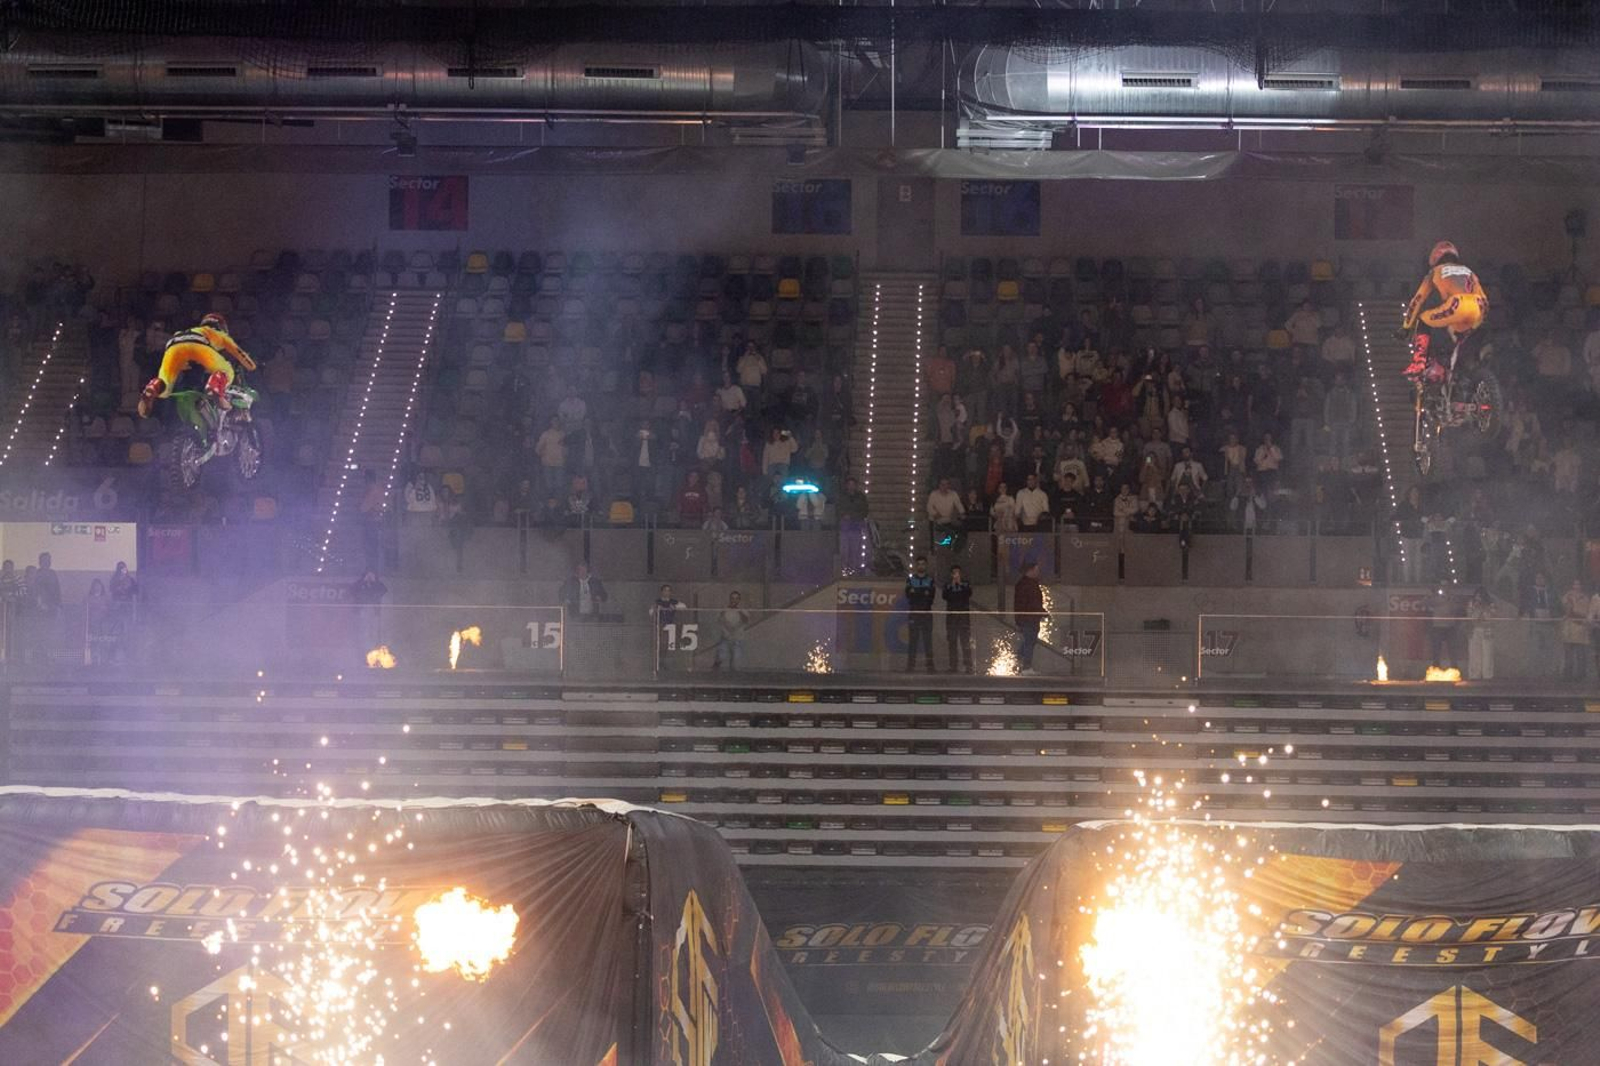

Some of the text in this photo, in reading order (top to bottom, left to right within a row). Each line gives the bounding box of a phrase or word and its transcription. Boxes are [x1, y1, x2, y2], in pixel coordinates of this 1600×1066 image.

[388, 175, 440, 189] Sector
[772, 182, 822, 194] Sector
[961, 182, 1012, 196] Sector
[402, 177, 467, 230] 14
[0, 475, 119, 511] Salida 6
[719, 532, 754, 544] Sector
[998, 534, 1034, 546] Sector
[287, 583, 347, 600] Sector
[838, 588, 897, 605] Sector
[526, 621, 561, 649] 15
[661, 623, 699, 651] 15
[1066, 630, 1102, 657] 17
[1204, 630, 1242, 657] 17
[1062, 645, 1093, 656] Sector
[1201, 646, 1231, 656] Sector
[80, 881, 259, 917] SOLO
[1282, 907, 1454, 942] SOLO
[776, 923, 903, 948] SOLO
